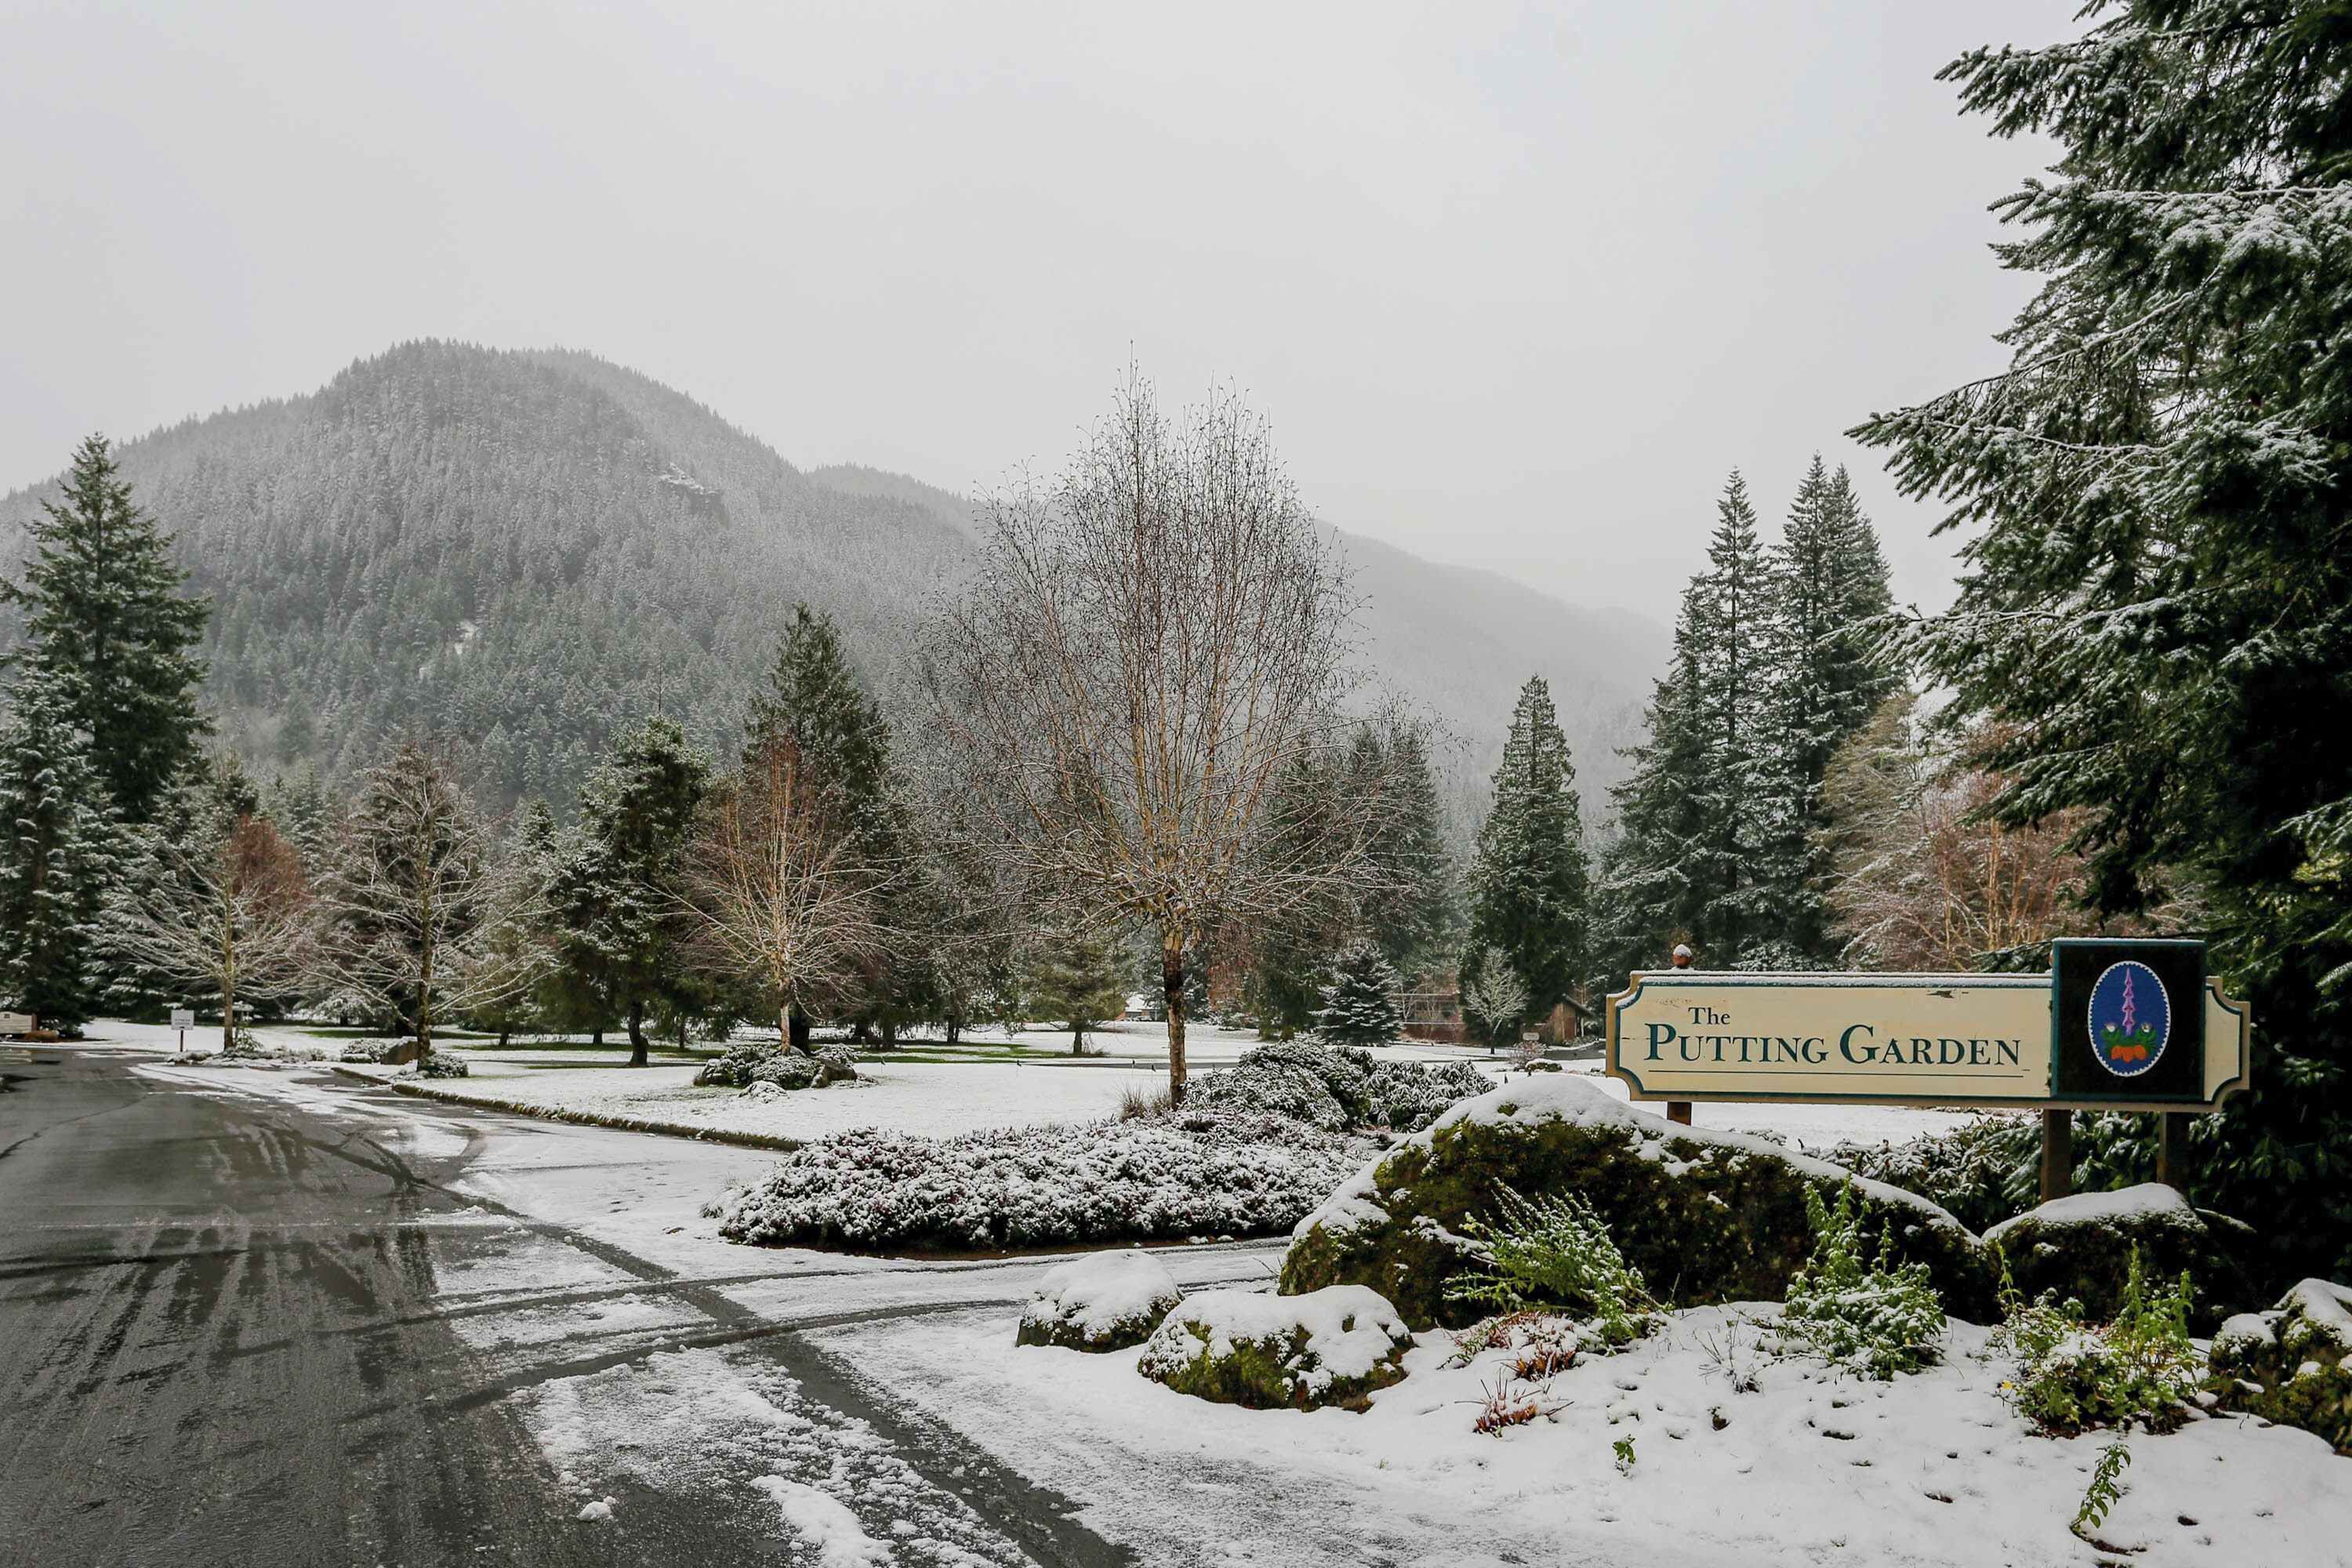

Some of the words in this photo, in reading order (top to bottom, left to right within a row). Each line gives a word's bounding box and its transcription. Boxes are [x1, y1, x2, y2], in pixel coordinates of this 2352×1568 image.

[1687, 1007, 1731, 1025] The
[1643, 1022, 1829, 1064] PUTTING
[1839, 1024, 2021, 1066] GARDEN
